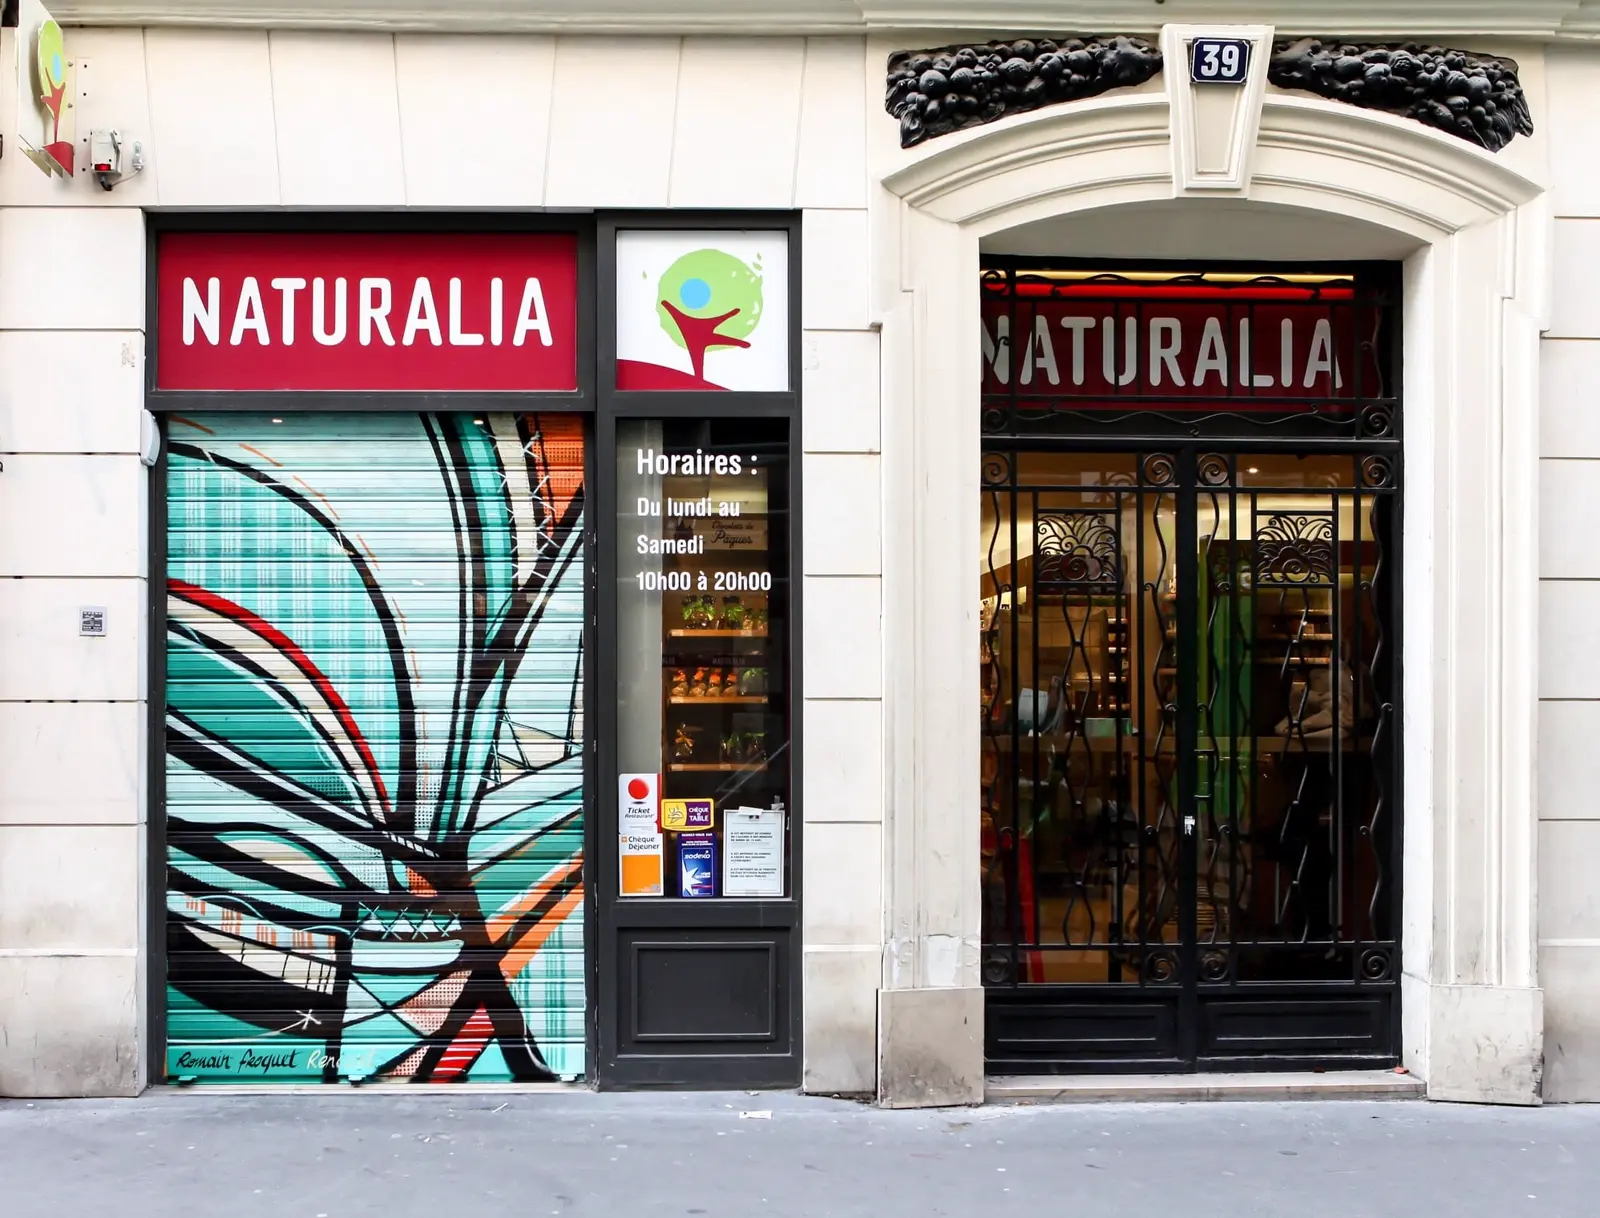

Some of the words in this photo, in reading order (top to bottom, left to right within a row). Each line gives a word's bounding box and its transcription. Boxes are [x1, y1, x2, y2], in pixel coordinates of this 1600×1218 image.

[1200, 44, 1240, 78] 39
[182, 276, 553, 347] NATURALIA
[981, 313, 1343, 389] NATURALIA
[637, 448, 742, 475] Horaires
[637, 497, 661, 516] Du
[667, 497, 712, 516] lundi
[718, 501, 740, 517] au
[637, 535, 704, 554] Samedi
[636, 571, 691, 591] 10h00
[697, 570, 708, 591] à
[714, 571, 771, 591] 20h00
[627, 807, 651, 815] Ticket
[684, 851, 711, 860] sodexo
